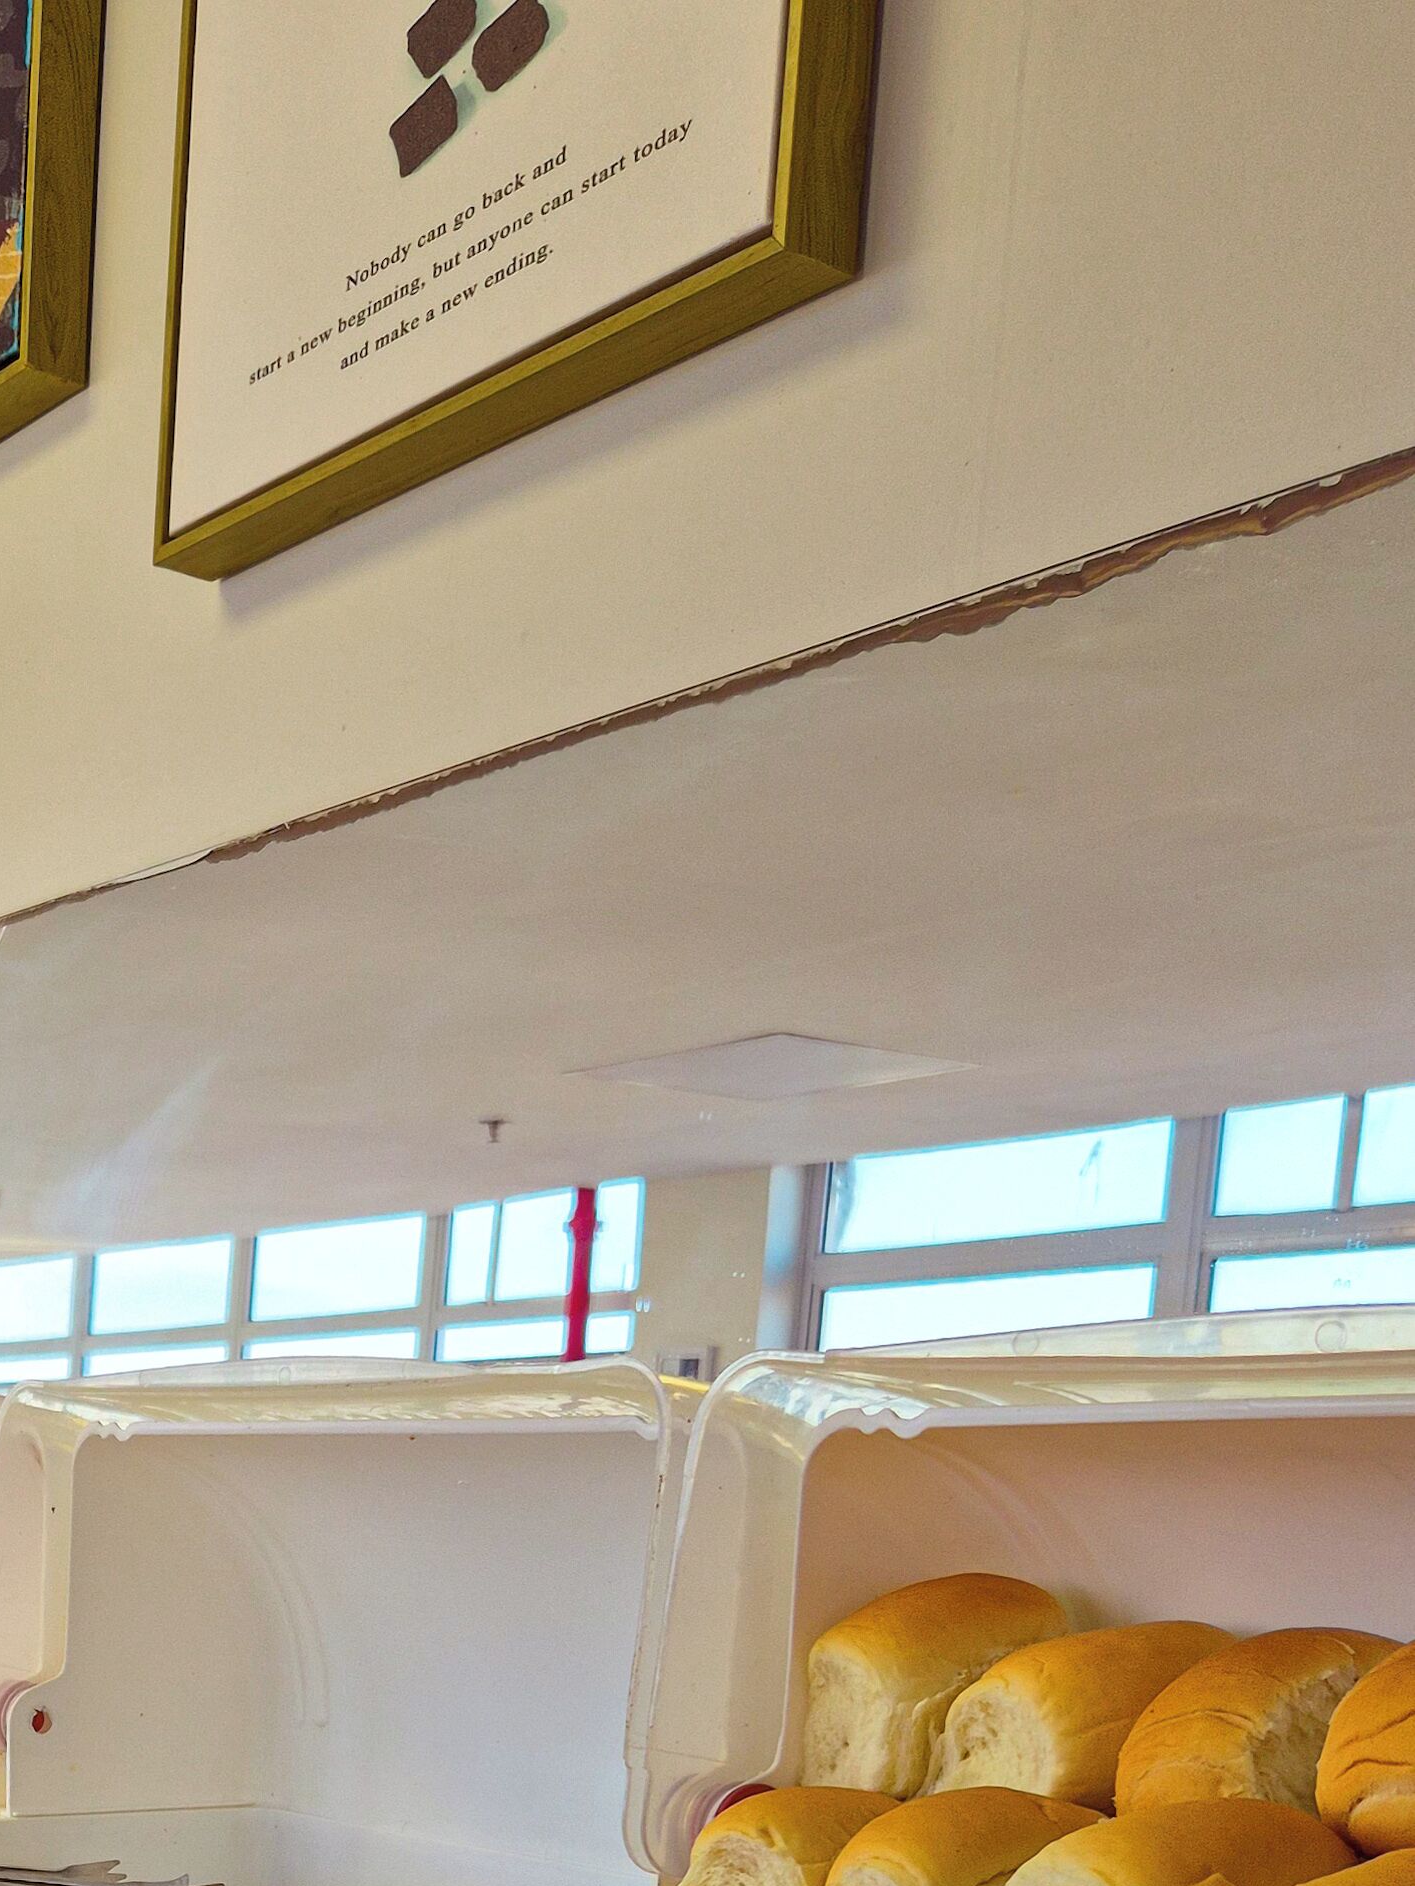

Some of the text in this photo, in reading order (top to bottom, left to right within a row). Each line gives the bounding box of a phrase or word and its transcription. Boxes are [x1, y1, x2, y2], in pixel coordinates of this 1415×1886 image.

[249, 119, 693, 385] start a new beginning, but anyone can start today
[345, 145, 567, 292] Nobody can go back and
[340, 243, 554, 370] and make a new ending.
